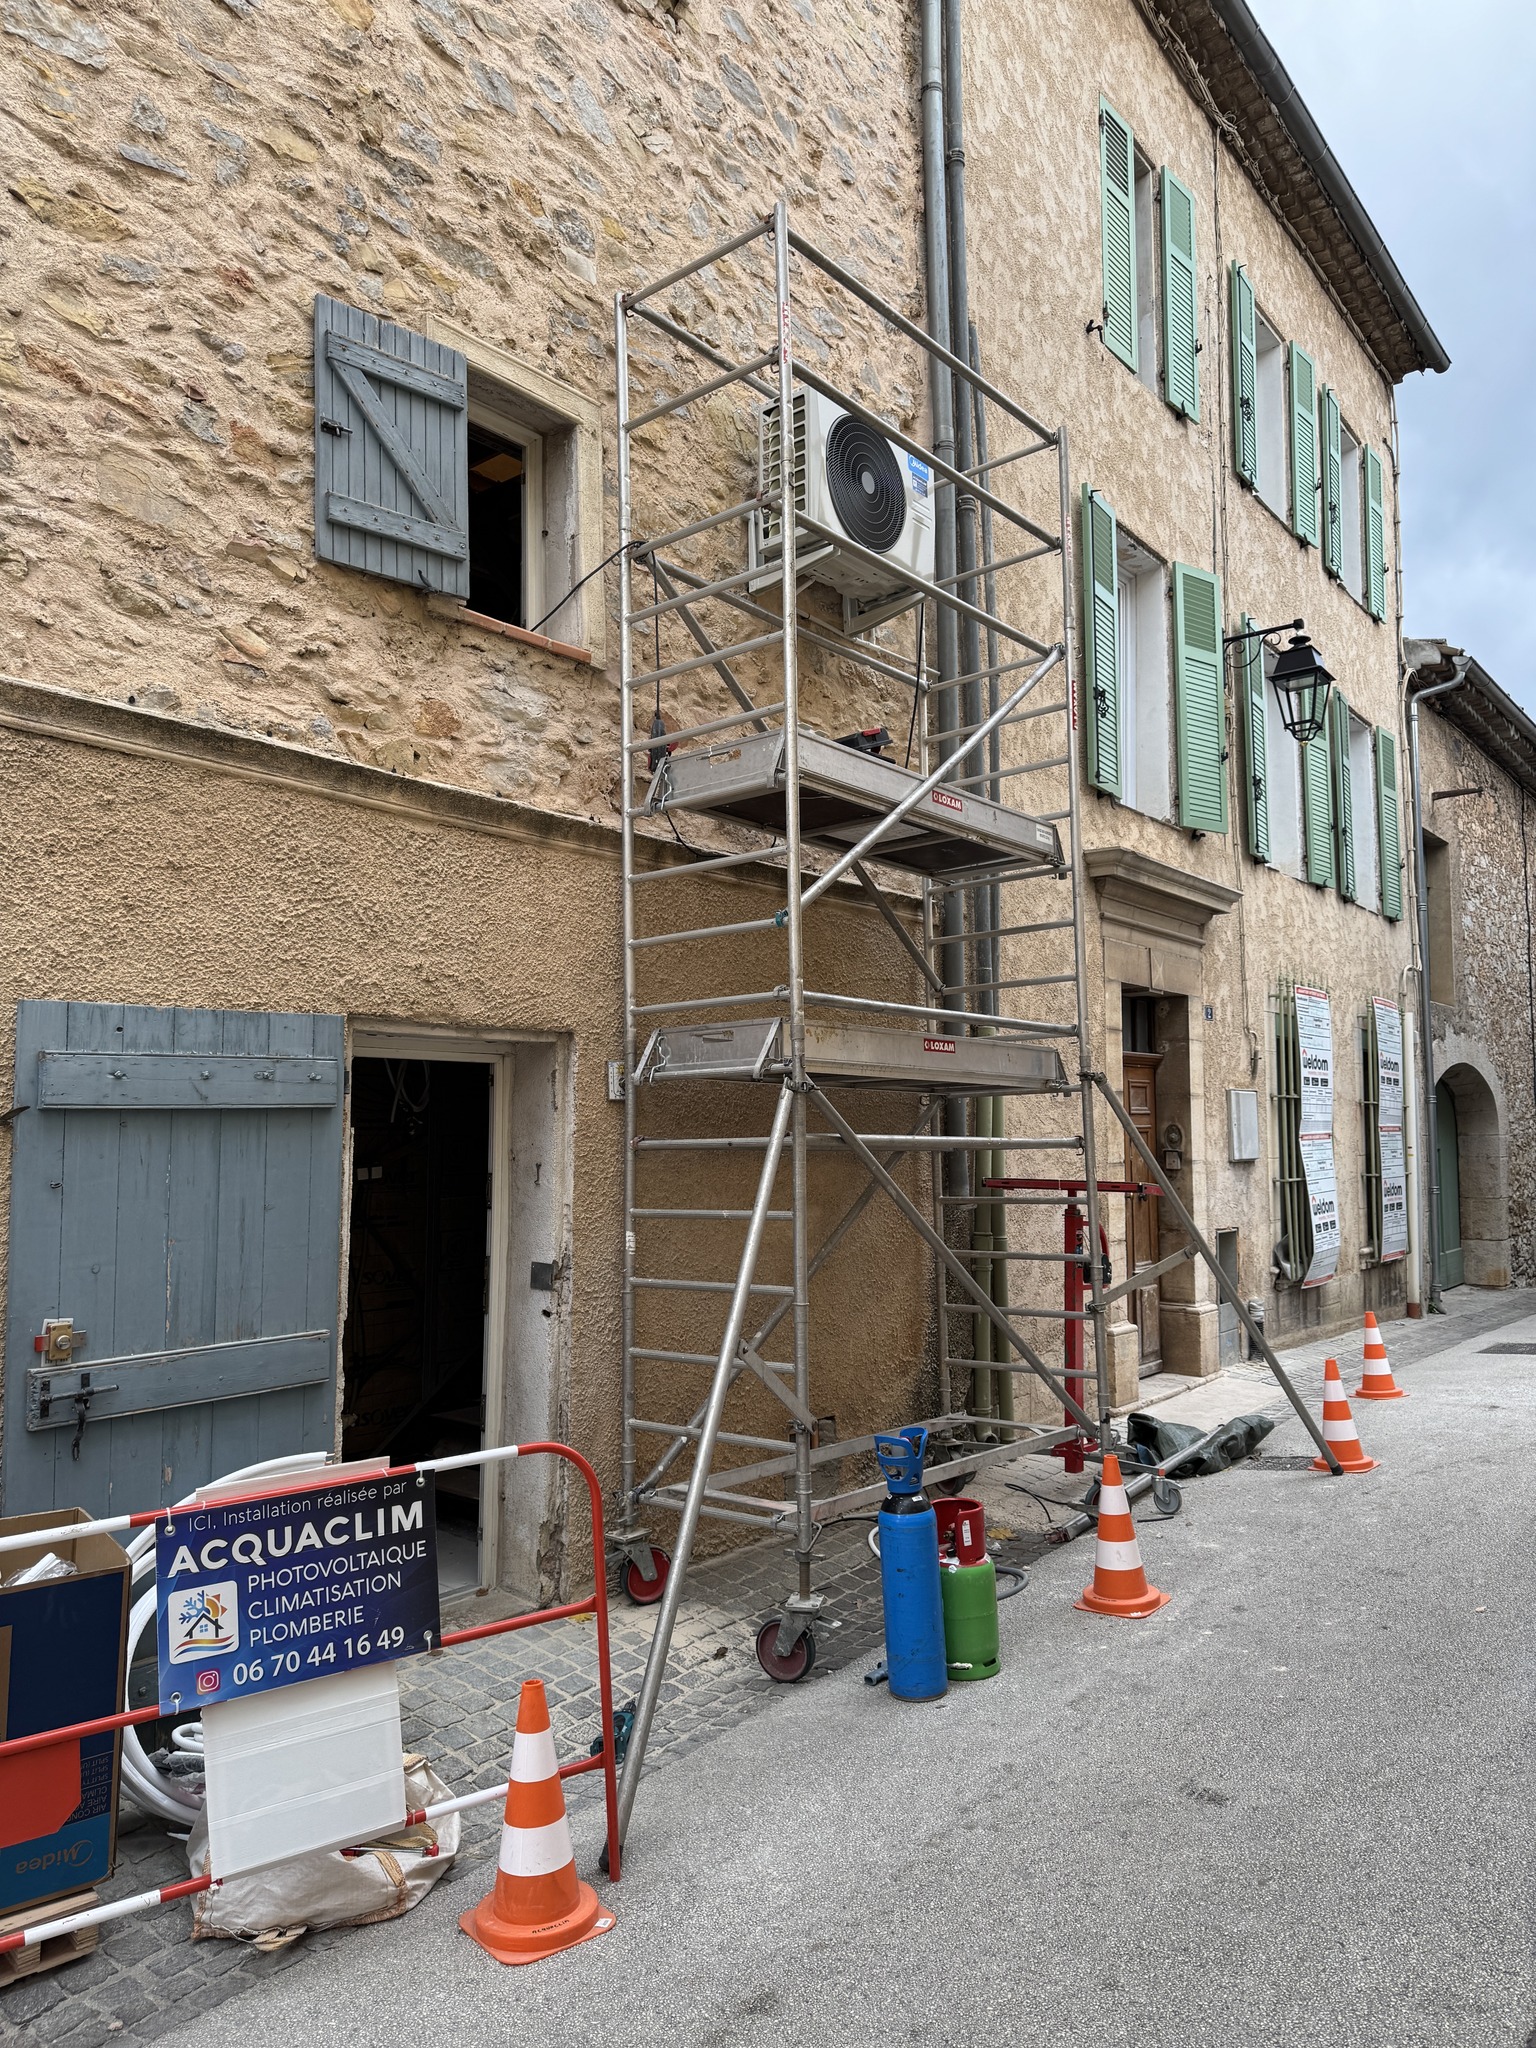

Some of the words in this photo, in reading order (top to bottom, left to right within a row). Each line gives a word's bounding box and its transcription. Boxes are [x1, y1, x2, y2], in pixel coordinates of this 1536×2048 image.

[939, 793, 962, 810] LOXAM
[930, 1041, 955, 1052] LOXAM
[1302, 1053, 1329, 1071] weldom
[1379, 1056, 1400, 1073] weldom
[1383, 1182, 1403, 1198] weldom
[1312, 1198, 1335, 1216] weldom
[188, 1515, 217, 1533] ICI,
[223, 1497, 311, 1527] Installation
[317, 1486, 377, 1508] réalisée
[383, 1480, 408, 1501] par
[167, 1500, 423, 1578] ACQUACLIM
[248, 1540, 427, 1593] PHOTOVOLTAIQUE
[248, 1571, 401, 1620] CLIMATISATION
[250, 1605, 364, 1648] PLOMBERIE
[232, 1661, 264, 1686] 06
[271, 1651, 300, 1676] 70
[306, 1642, 336, 1667] 44
[343, 1633, 371, 1659] 16
[376, 1625, 405, 1650] 49
[92, 1803, 107, 1814] AIR
[15, 1839, 94, 1874] Midea
